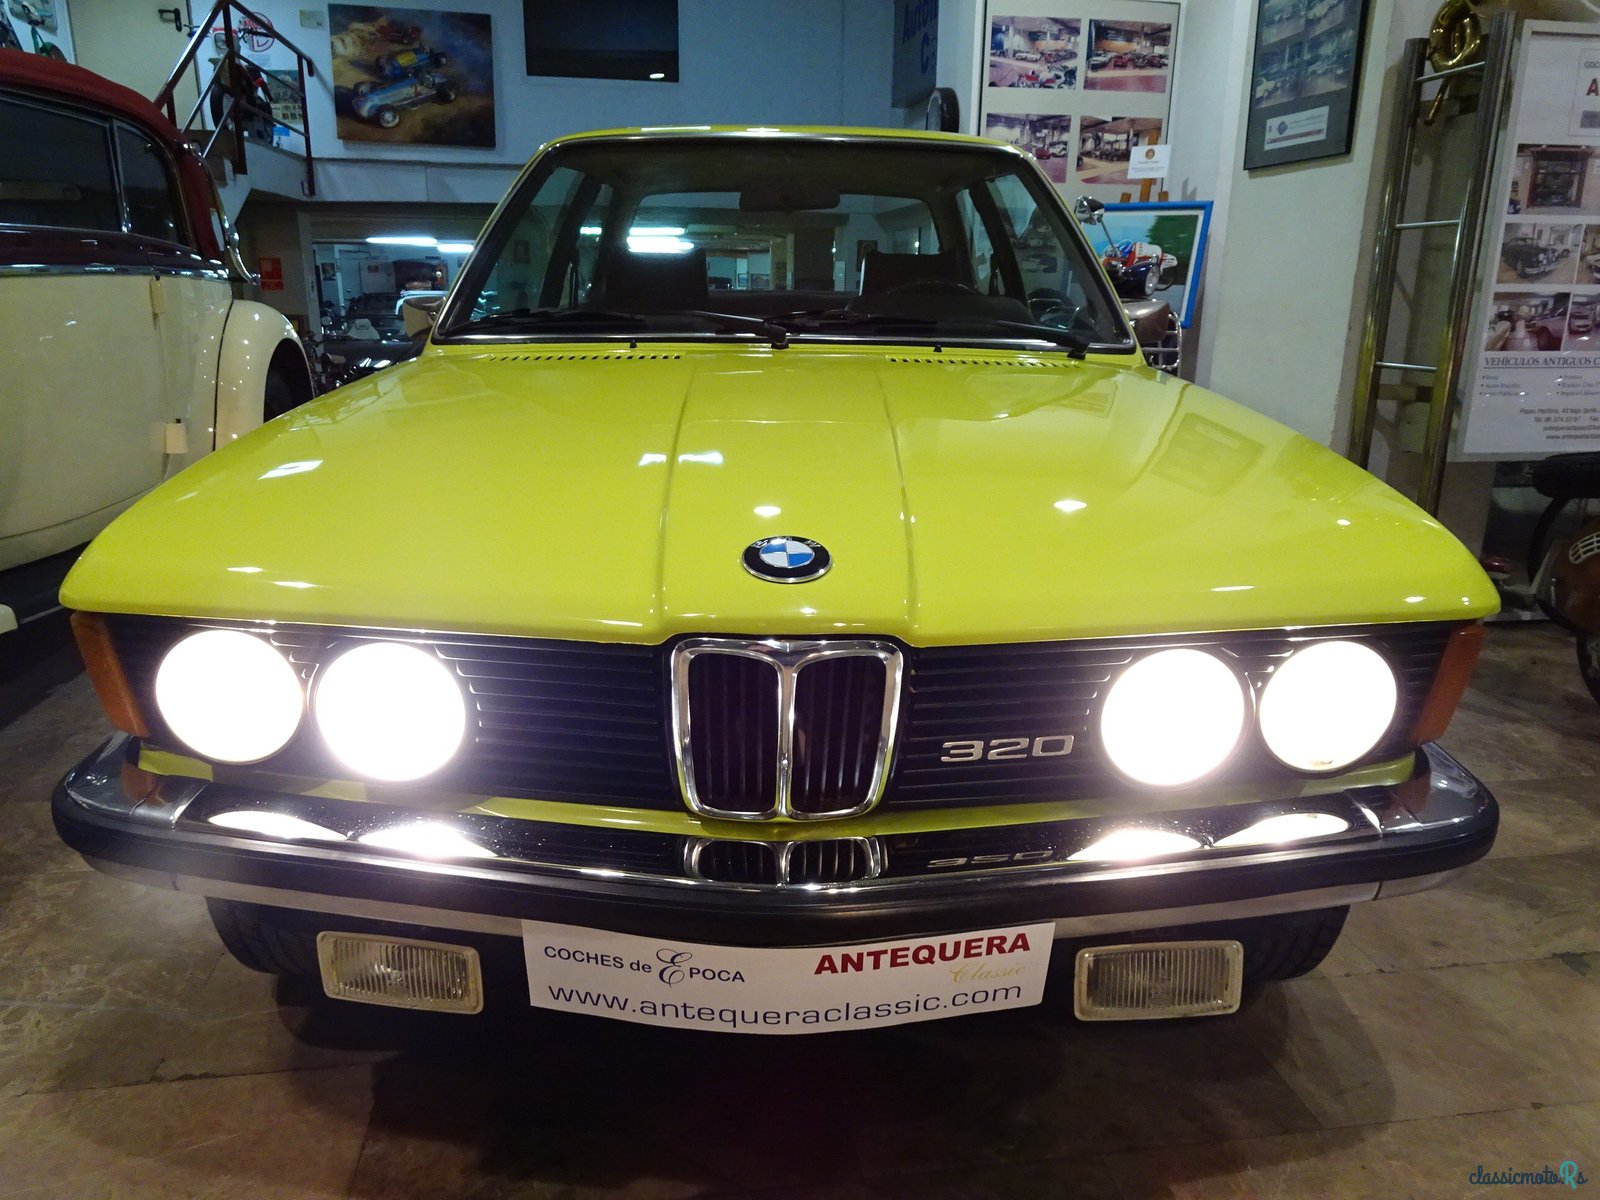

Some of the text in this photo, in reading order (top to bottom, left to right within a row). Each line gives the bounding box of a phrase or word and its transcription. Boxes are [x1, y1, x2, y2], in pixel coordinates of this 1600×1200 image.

[1542, 356, 1592, 366] ANTIGUOS
[940, 734, 1075, 763] 320
[544, 946, 624, 969] COCHES
[629, 960, 652, 973] de
[814, 932, 1031, 975] ANTEQUERA
[949, 961, 1027, 985] Classic
[548, 985, 1022, 1028] www.antequeraclassic.com
